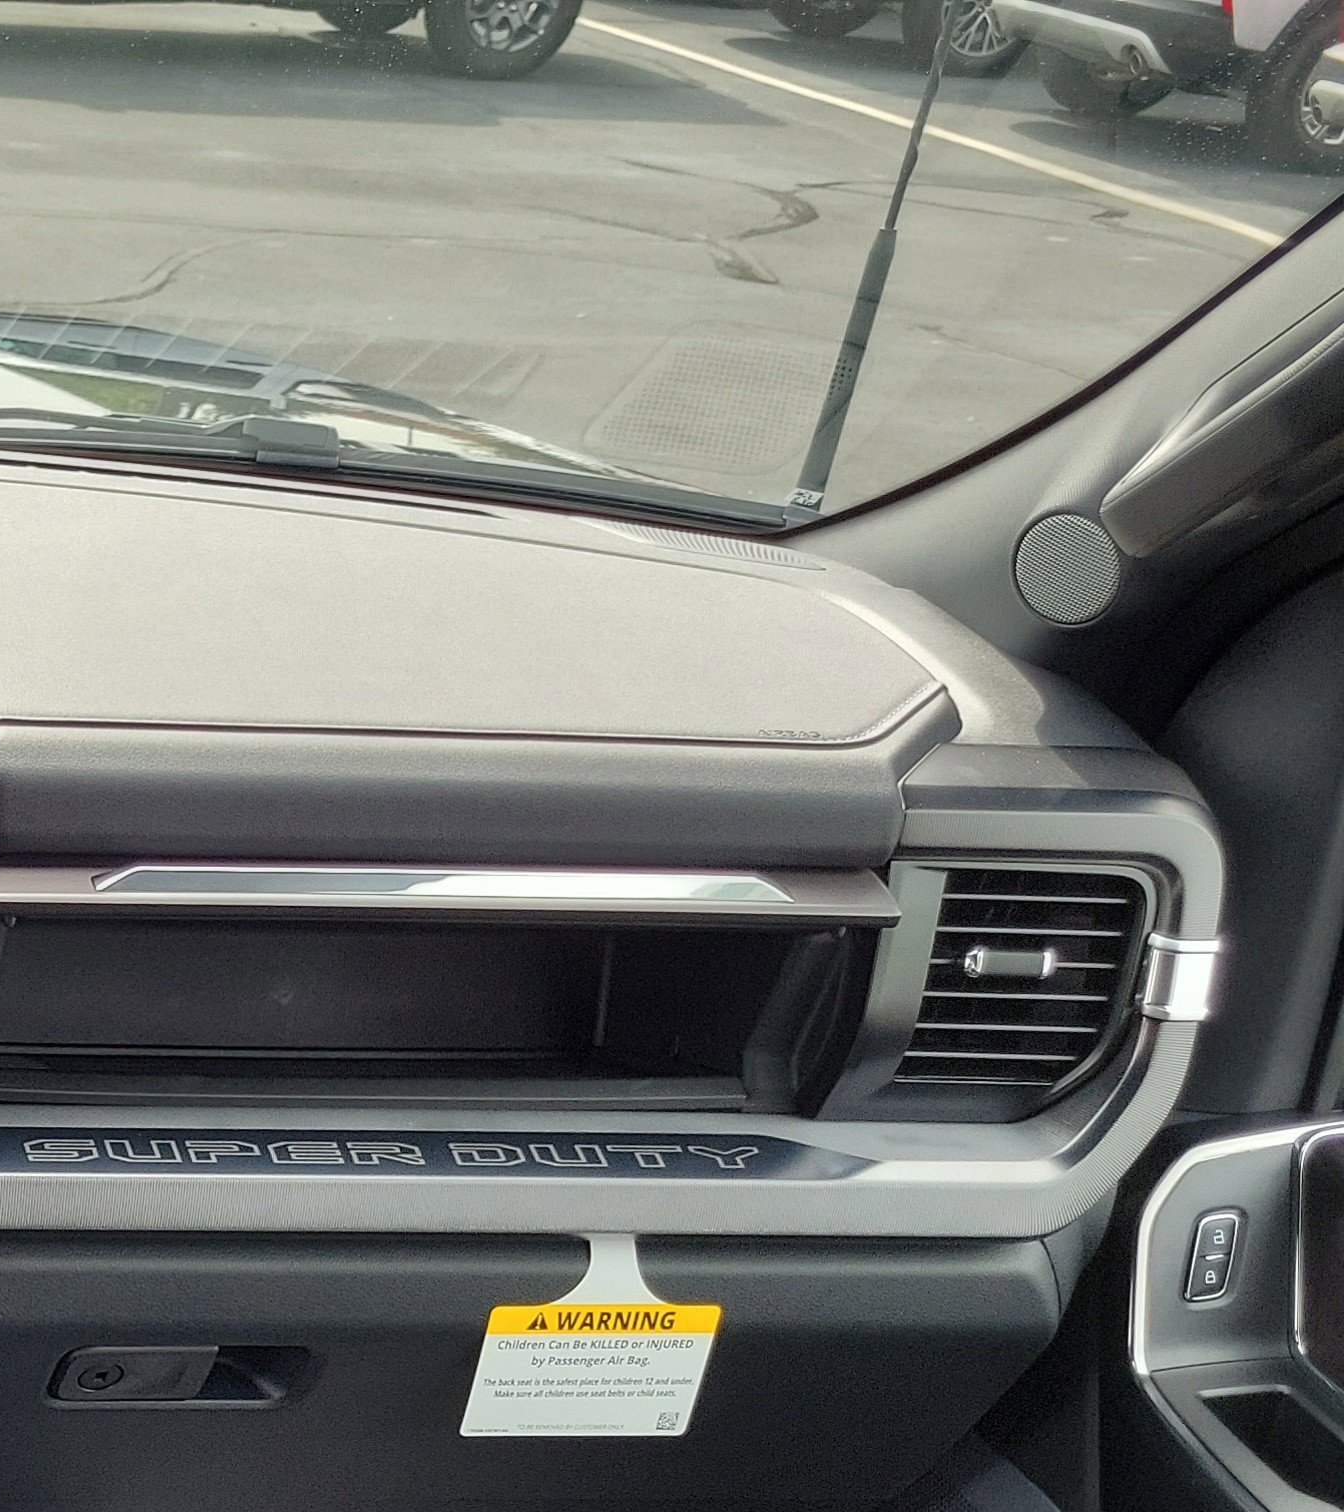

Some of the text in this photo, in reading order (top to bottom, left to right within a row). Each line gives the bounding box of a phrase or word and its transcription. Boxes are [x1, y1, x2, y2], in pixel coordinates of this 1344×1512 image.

[22, 1137, 760, 1170] SUPER DUTY
[557, 1311, 677, 1331] WARNING
[497, 1339, 694, 1351] Children Can Be KILLED or INJURED
[530, 1356, 651, 1368] by Passenger Air Bag.
[483, 1378, 497, 1387] The
[497, 1378, 515, 1387] back
[516, 1378, 532, 1387] seat
[533, 1378, 541, 1387] is
[542, 1378, 555, 1387] the
[556, 1378, 578, 1387] safest
[578, 1378, 599, 1387] place
[599, 1377, 612, 1386] for
[613, 1377, 643, 1386] children
[644, 1377, 654, 1386] 12
[654, 1377, 669, 1386] and
[493, 1390, 514, 1398] Make
[516, 1390, 532, 1398] sure
[533, 1390, 544, 1398] all
[544, 1390, 574, 1398] children
[575, 1390, 589, 1398] use
[590, 1390, 607, 1398] seat
[608, 1389, 626, 1398] belts
[627, 1390, 636, 1398] or
[637, 1389, 655, 1397] child
